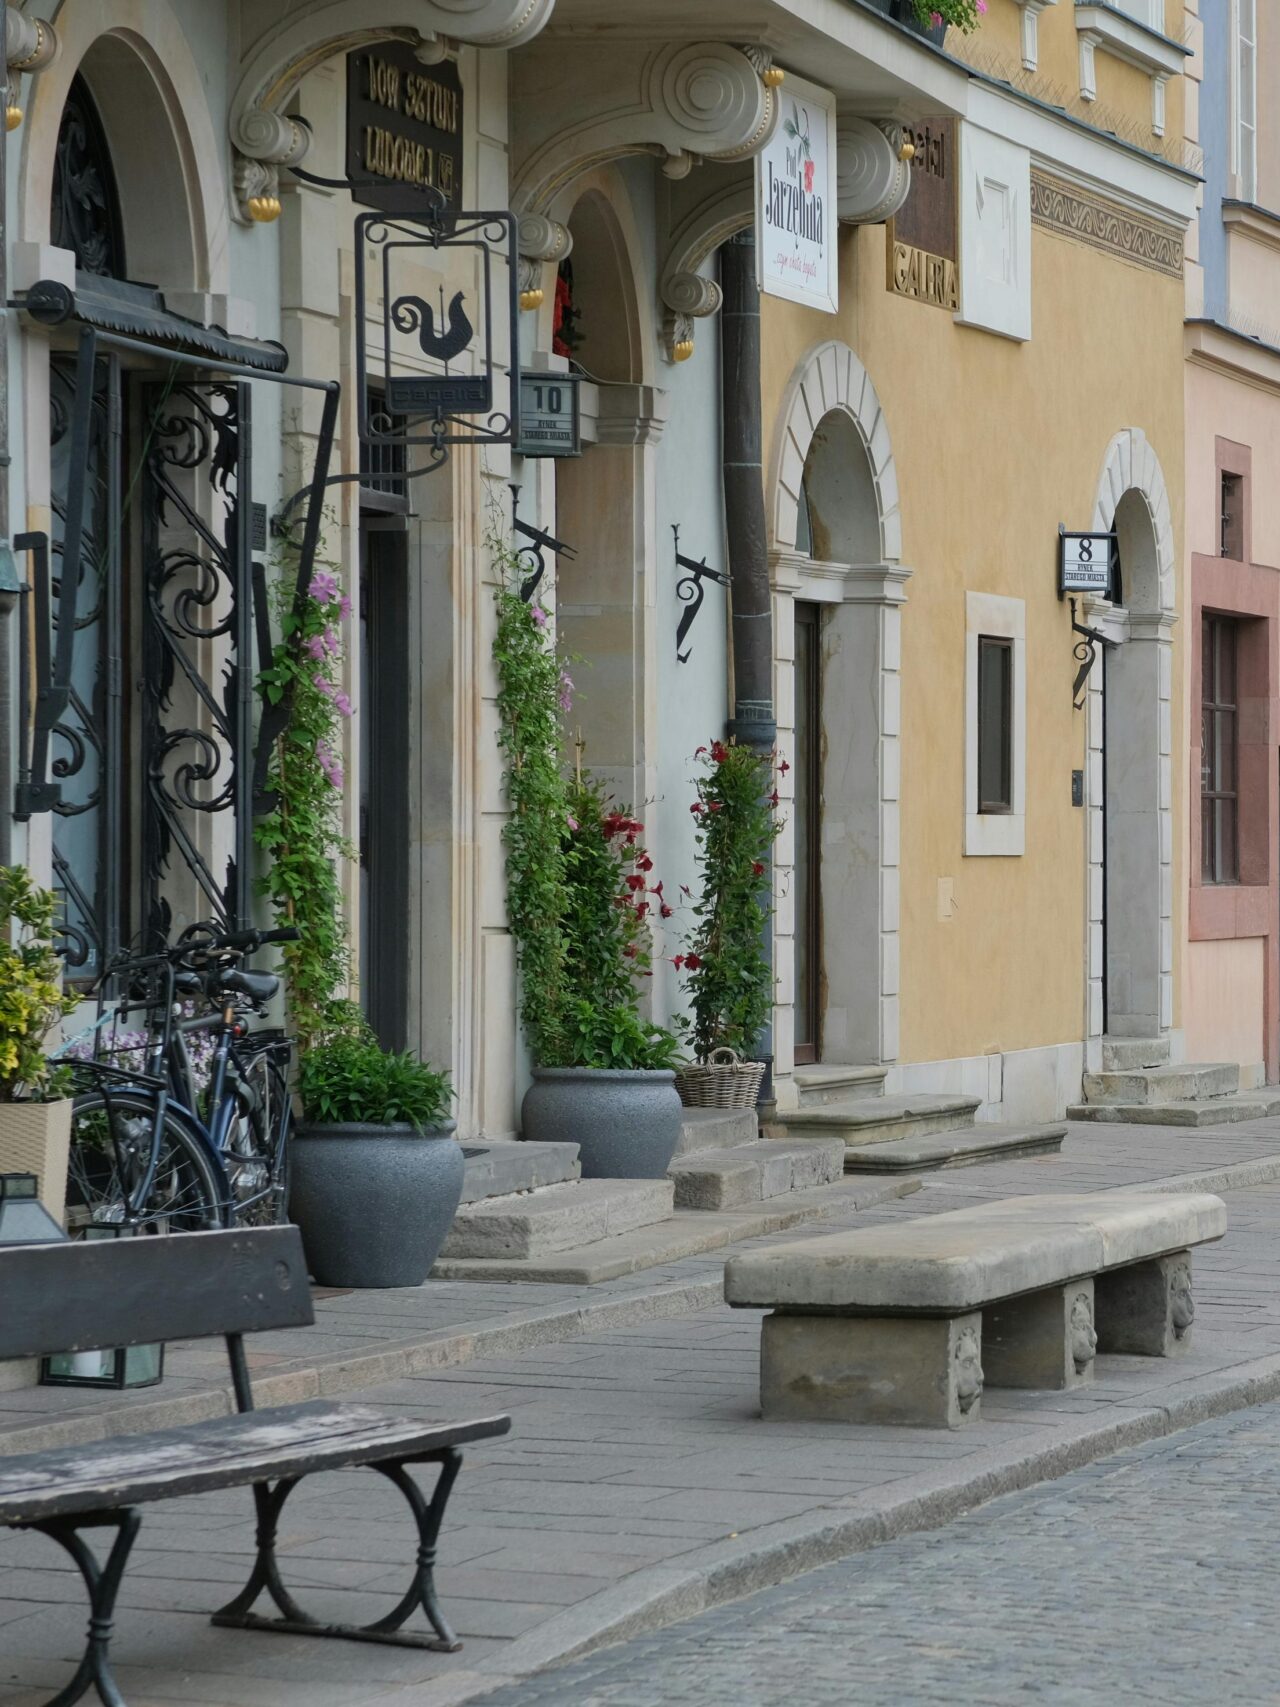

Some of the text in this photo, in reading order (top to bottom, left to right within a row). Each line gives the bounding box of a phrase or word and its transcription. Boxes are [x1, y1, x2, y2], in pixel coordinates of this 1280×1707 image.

[786, 146, 797, 179] Pod
[895, 244, 958, 310] GALERIA
[533, 386, 561, 414] 10
[1079, 538, 1092, 562] 8
